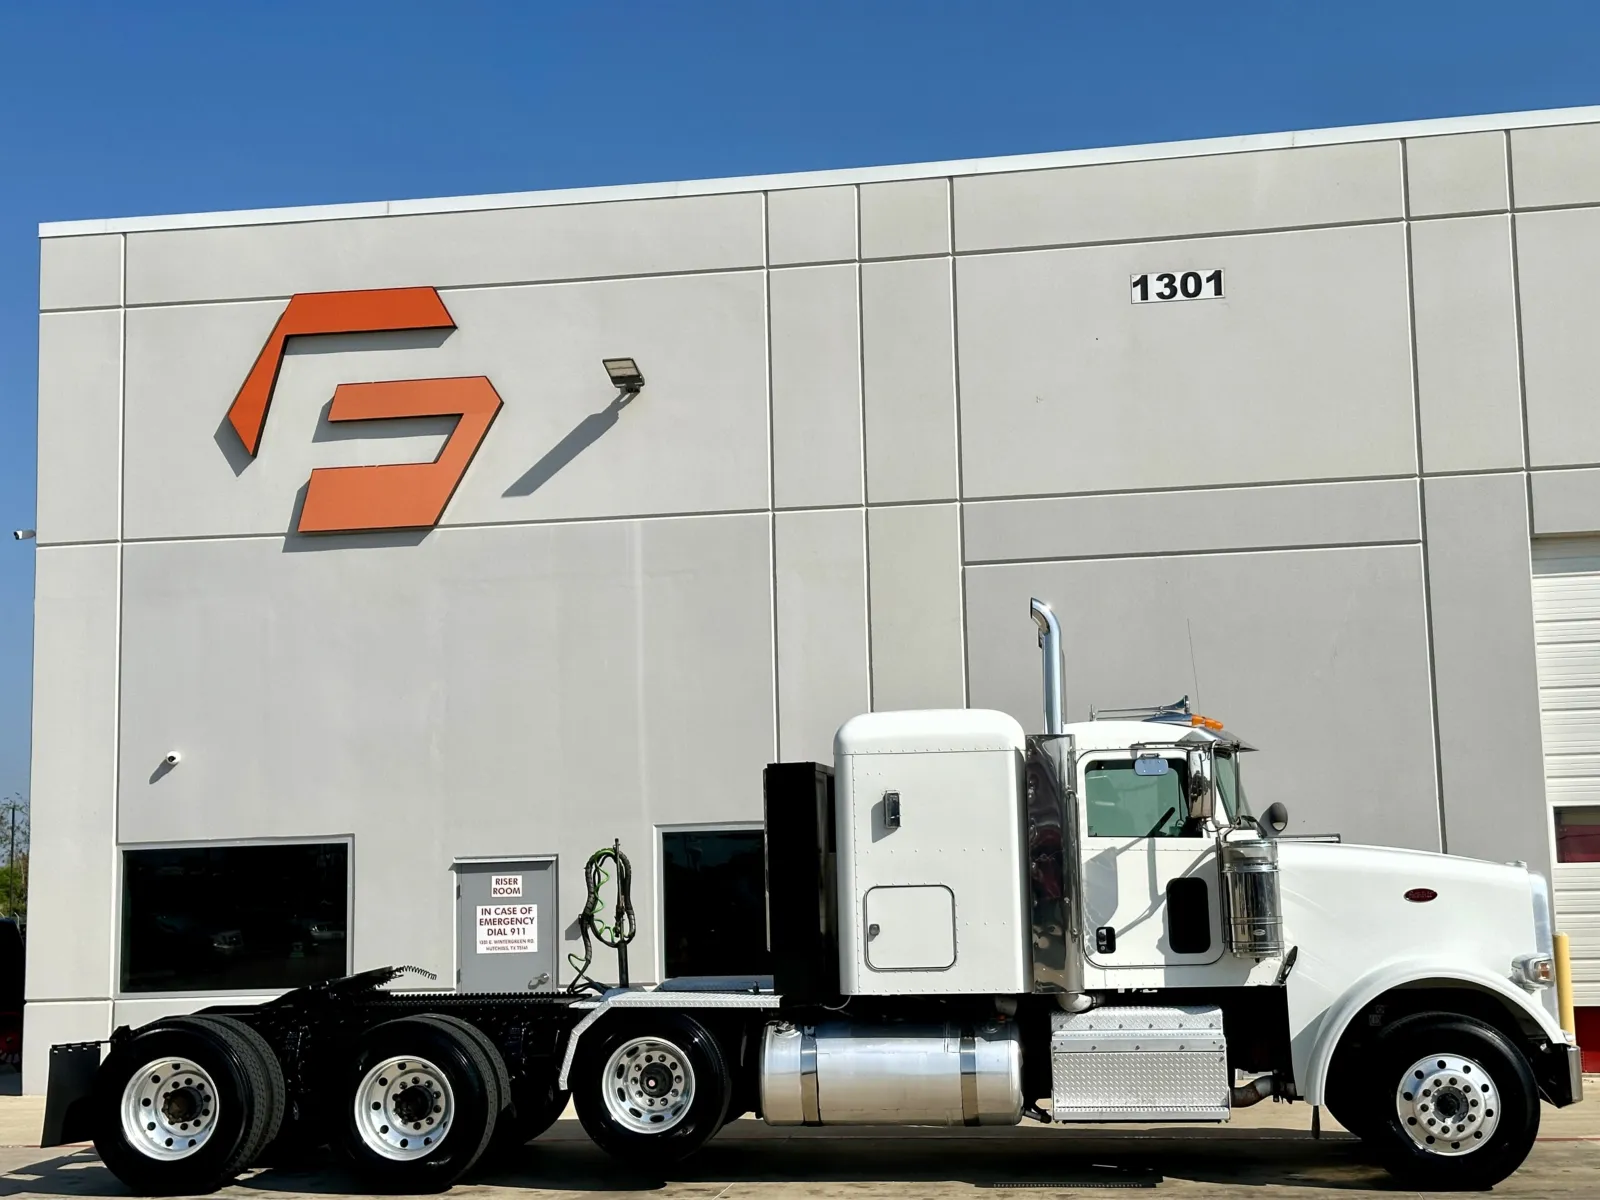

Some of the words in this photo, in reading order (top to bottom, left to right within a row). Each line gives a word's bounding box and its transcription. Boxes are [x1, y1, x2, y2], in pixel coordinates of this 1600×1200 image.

[1132, 269, 1223, 301] 1301
[495, 877, 519, 886] RISER
[492, 887, 521, 895] ROOM
[481, 907, 491, 916] IN
[494, 907, 517, 916] CASE
[519, 906, 533, 915] OF
[479, 916, 535, 926] EMERGENCY
[487, 928, 508, 936] DIAL
[510, 927, 526, 936] 911
